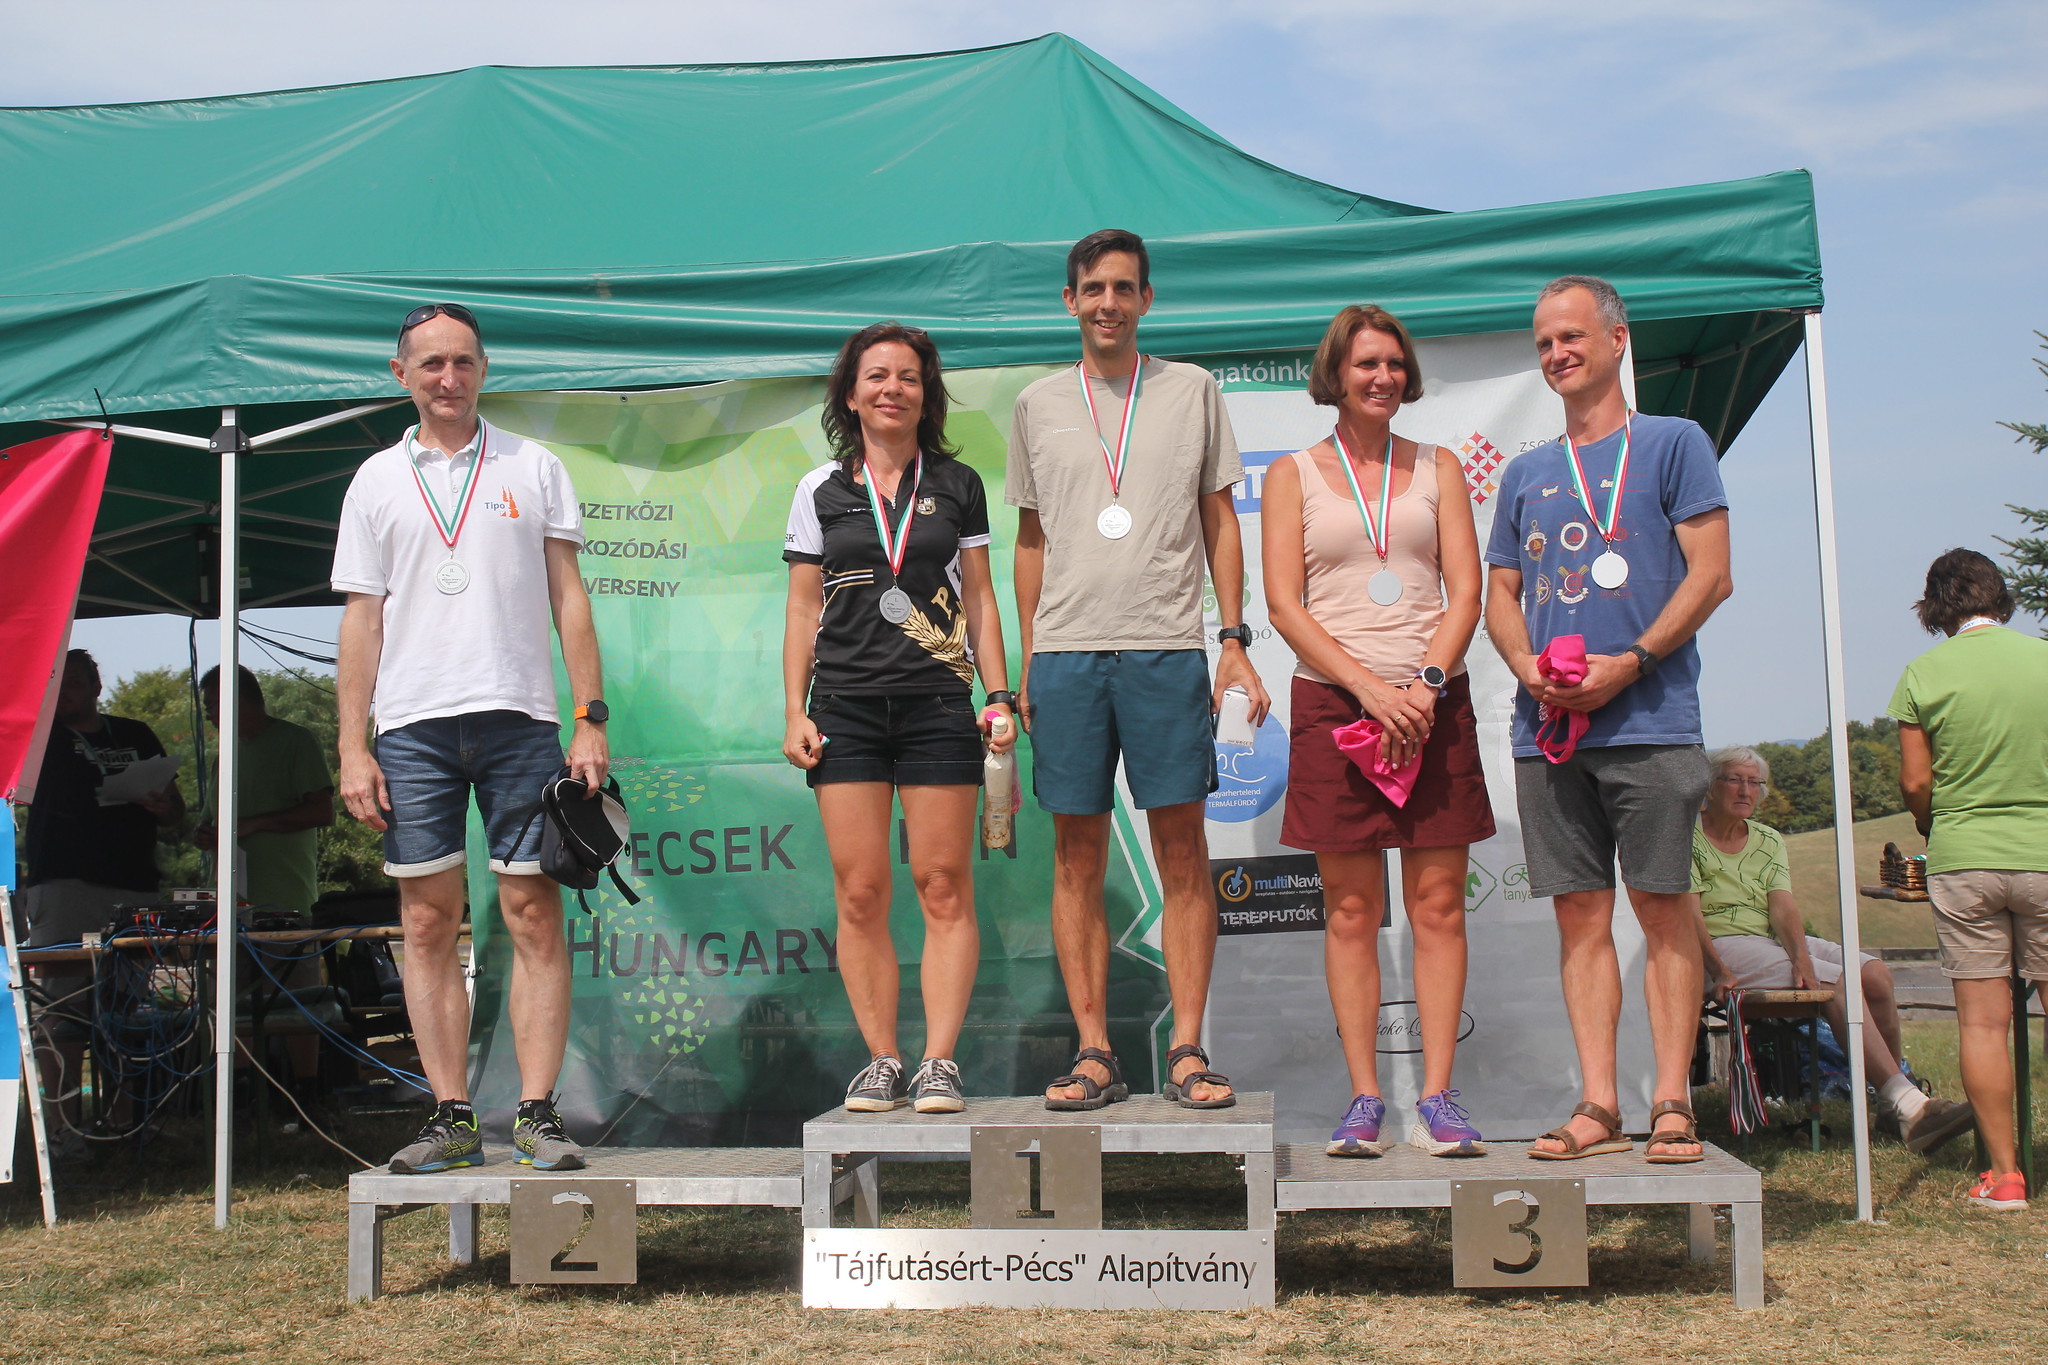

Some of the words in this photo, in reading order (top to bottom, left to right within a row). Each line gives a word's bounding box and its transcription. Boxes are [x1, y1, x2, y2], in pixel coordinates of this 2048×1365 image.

[1210, 358, 1310, 390] gatóink
[484, 501, 506, 511] Tipo
[577, 538, 687, 559] KOZÓDÁSI
[583, 577, 680, 598] VERSENY
[606, 823, 797, 878] ECSEK
[1015, 1138, 1055, 1219] 1
[550, 1191, 598, 1272] 2
[1493, 1190, 1542, 1275] 3
[816, 1250, 1087, 1287] "Tájfutásért-Pécs"
[1098, 1250, 1258, 1289] Alapítvány
